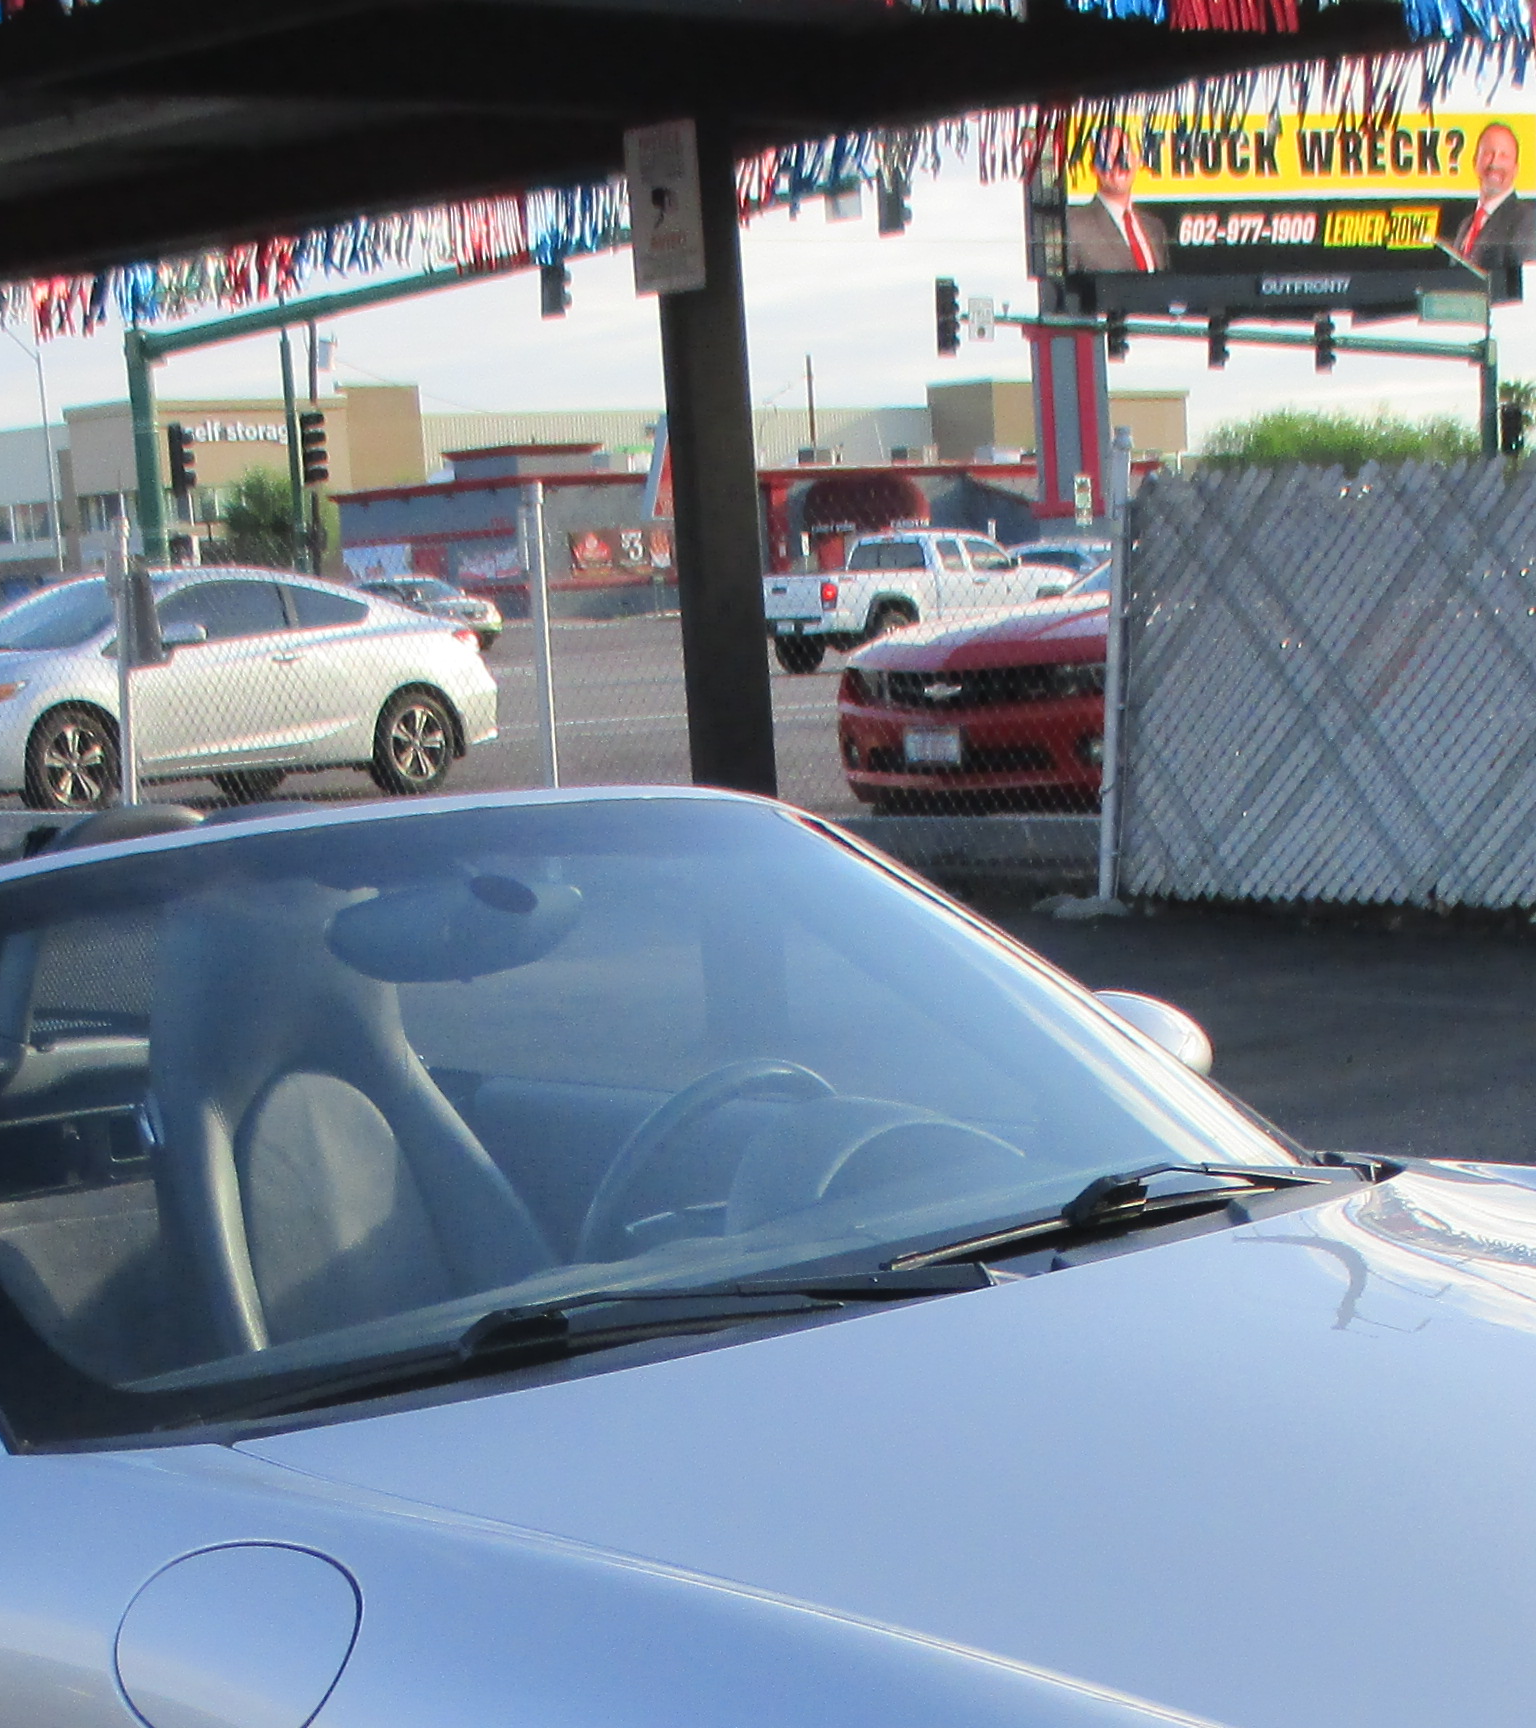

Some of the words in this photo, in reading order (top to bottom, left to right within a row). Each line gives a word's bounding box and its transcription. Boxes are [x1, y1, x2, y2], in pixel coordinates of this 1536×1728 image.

[1147, 128, 1280, 178] TRUCK
[1296, 127, 1465, 178] WRECK?
[1179, 213, 1318, 247] 602-977-1900
[1323, 210, 1386, 248] LERNER
[226, 420, 289, 446] storag
